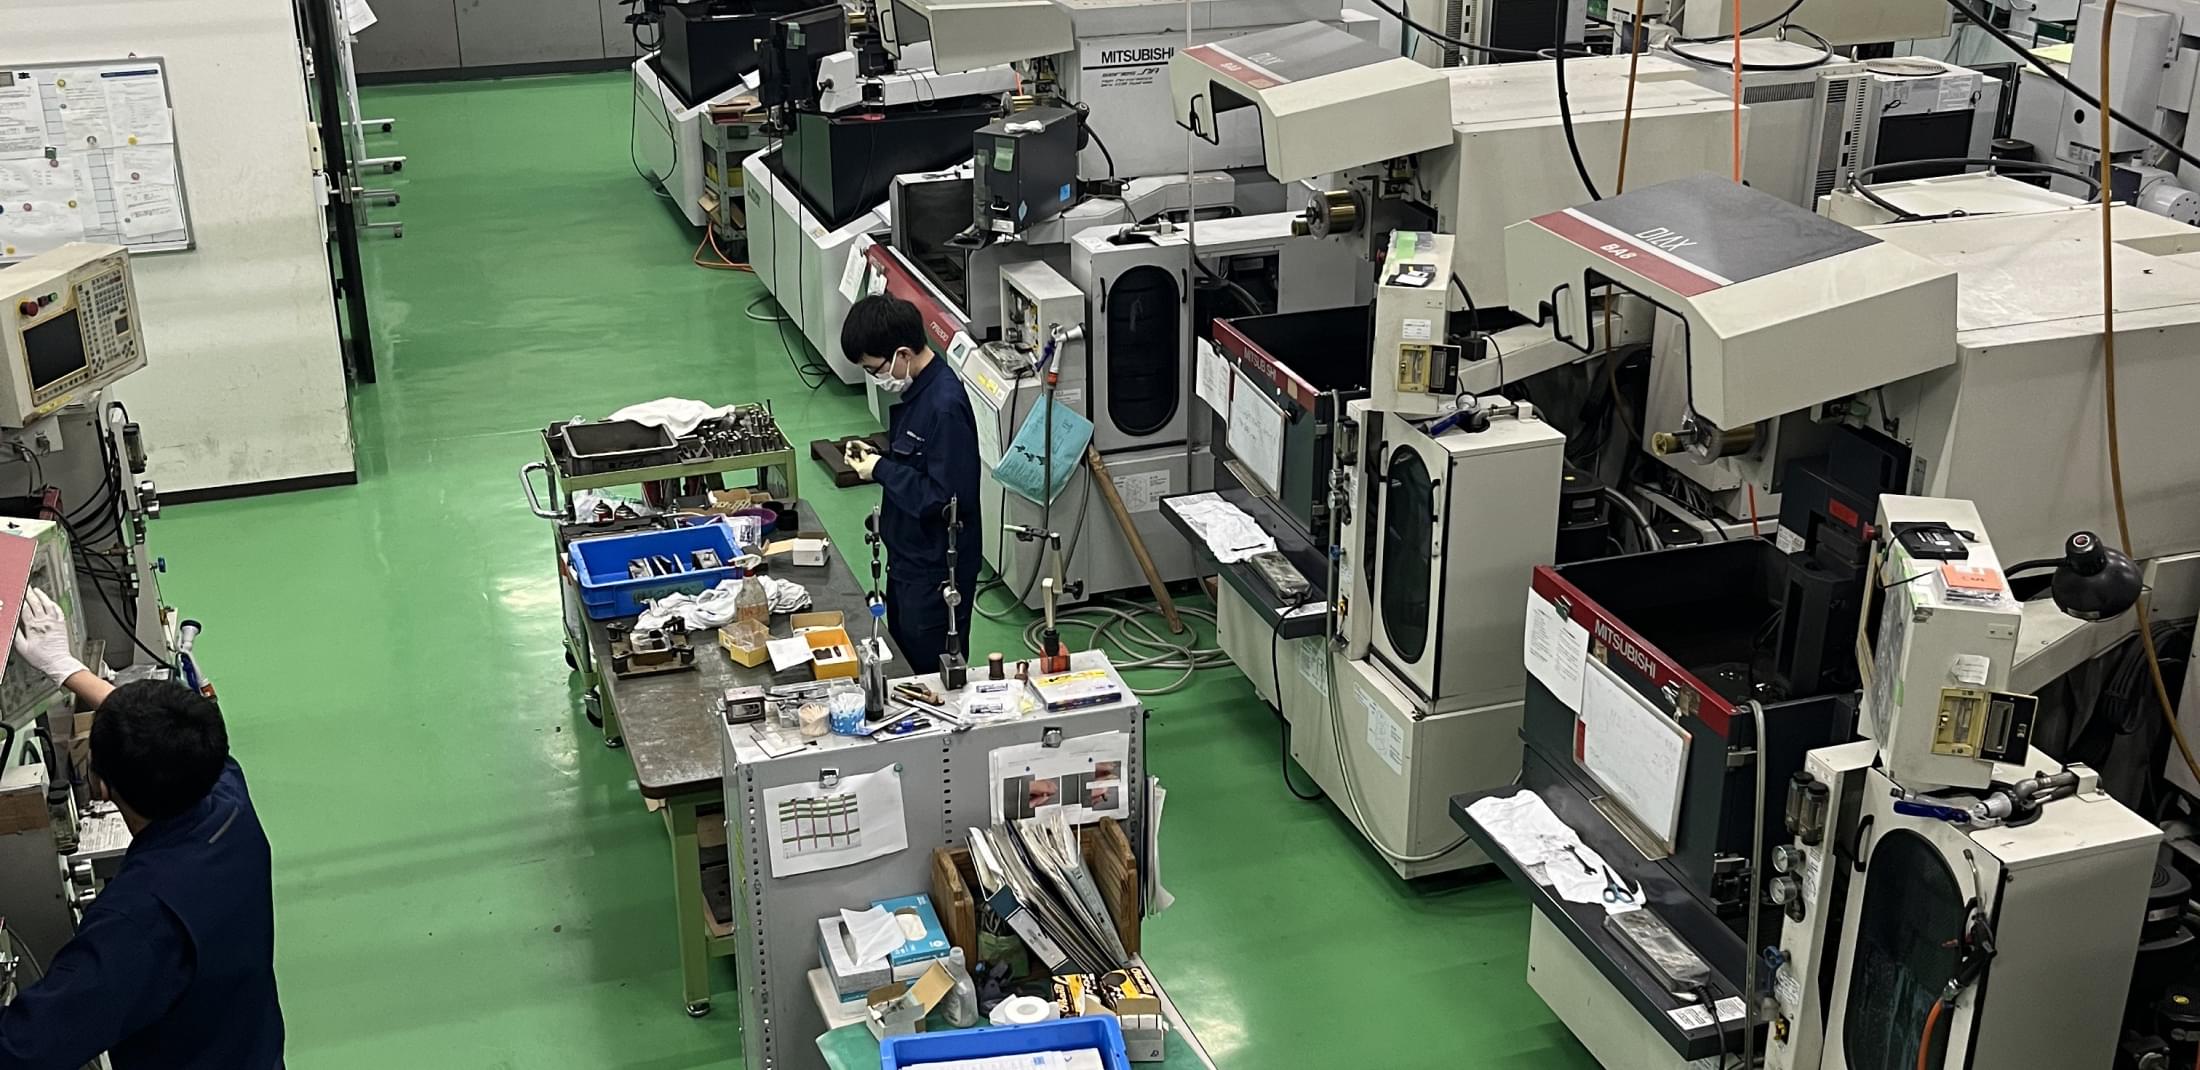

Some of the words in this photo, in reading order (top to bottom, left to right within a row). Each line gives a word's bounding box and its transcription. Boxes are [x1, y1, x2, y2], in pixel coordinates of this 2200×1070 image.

[1101, 47, 1174, 64] MITSUBISHI
[1243, 345, 1277, 382] MITSUBISHI
[1594, 619, 1657, 679] MITSUBISHI
